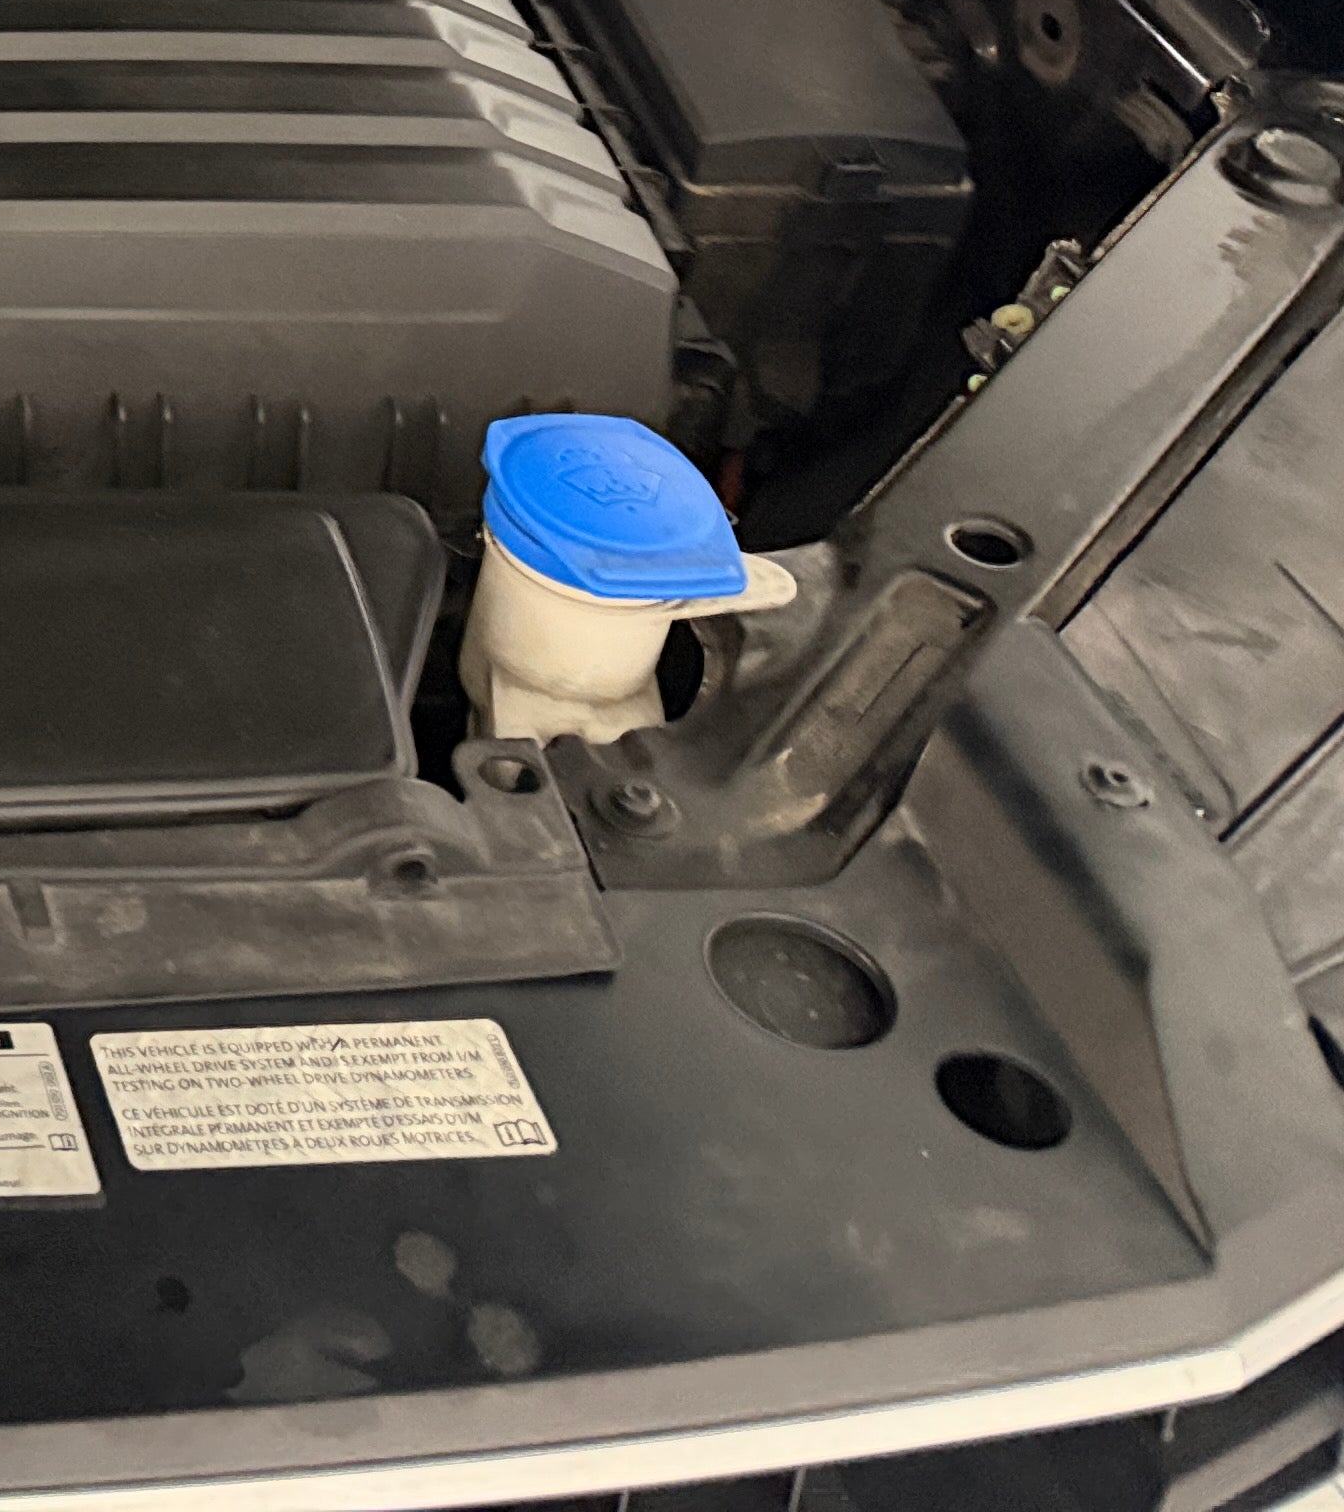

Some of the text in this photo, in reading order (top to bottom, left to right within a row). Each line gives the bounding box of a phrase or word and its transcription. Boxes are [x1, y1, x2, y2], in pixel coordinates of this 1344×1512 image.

[99, 1046, 136, 1059] THIS
[135, 1043, 200, 1057] VEHICLE
[201, 1042, 216, 1055] IS
[217, 1039, 295, 1056] EQUIPPED
[337, 1038, 351, 1050] A
[351, 1034, 444, 1049] PERMANENT
[105, 1061, 190, 1075] ALL-WHEEL
[191, 1059, 238, 1072] DRIVE
[238, 1057, 296, 1070] SYSTEM
[297, 1056, 334, 1068] AND
[350, 1052, 410, 1066] EXEMPT
[410, 1051, 455, 1063] FROM
[111, 1078, 176, 1092] TESTING
[176, 1077, 204, 1090] ON
[205, 1073, 301, 1088] TWO-WHEEL
[301, 1071, 352, 1085] DRIVE
[120, 1091, 524, 1120] CE VÉHICULE EST DOTÉ D'UN SYSTÈME DE TRANSMISSION
[126, 1121, 206, 1138] INTÉGRALE
[207, 1120, 296, 1135] PERMANENT
[296, 1119, 316, 1131] ET
[315, 1114, 381, 1130] EXEMPTÉ
[381, 1113, 444, 1127] D'ESSAIS
[132, 1143, 165, 1156] SUR
[303, 1135, 348, 1148] DEUX
[347, 1133, 401, 1146] ROUES
